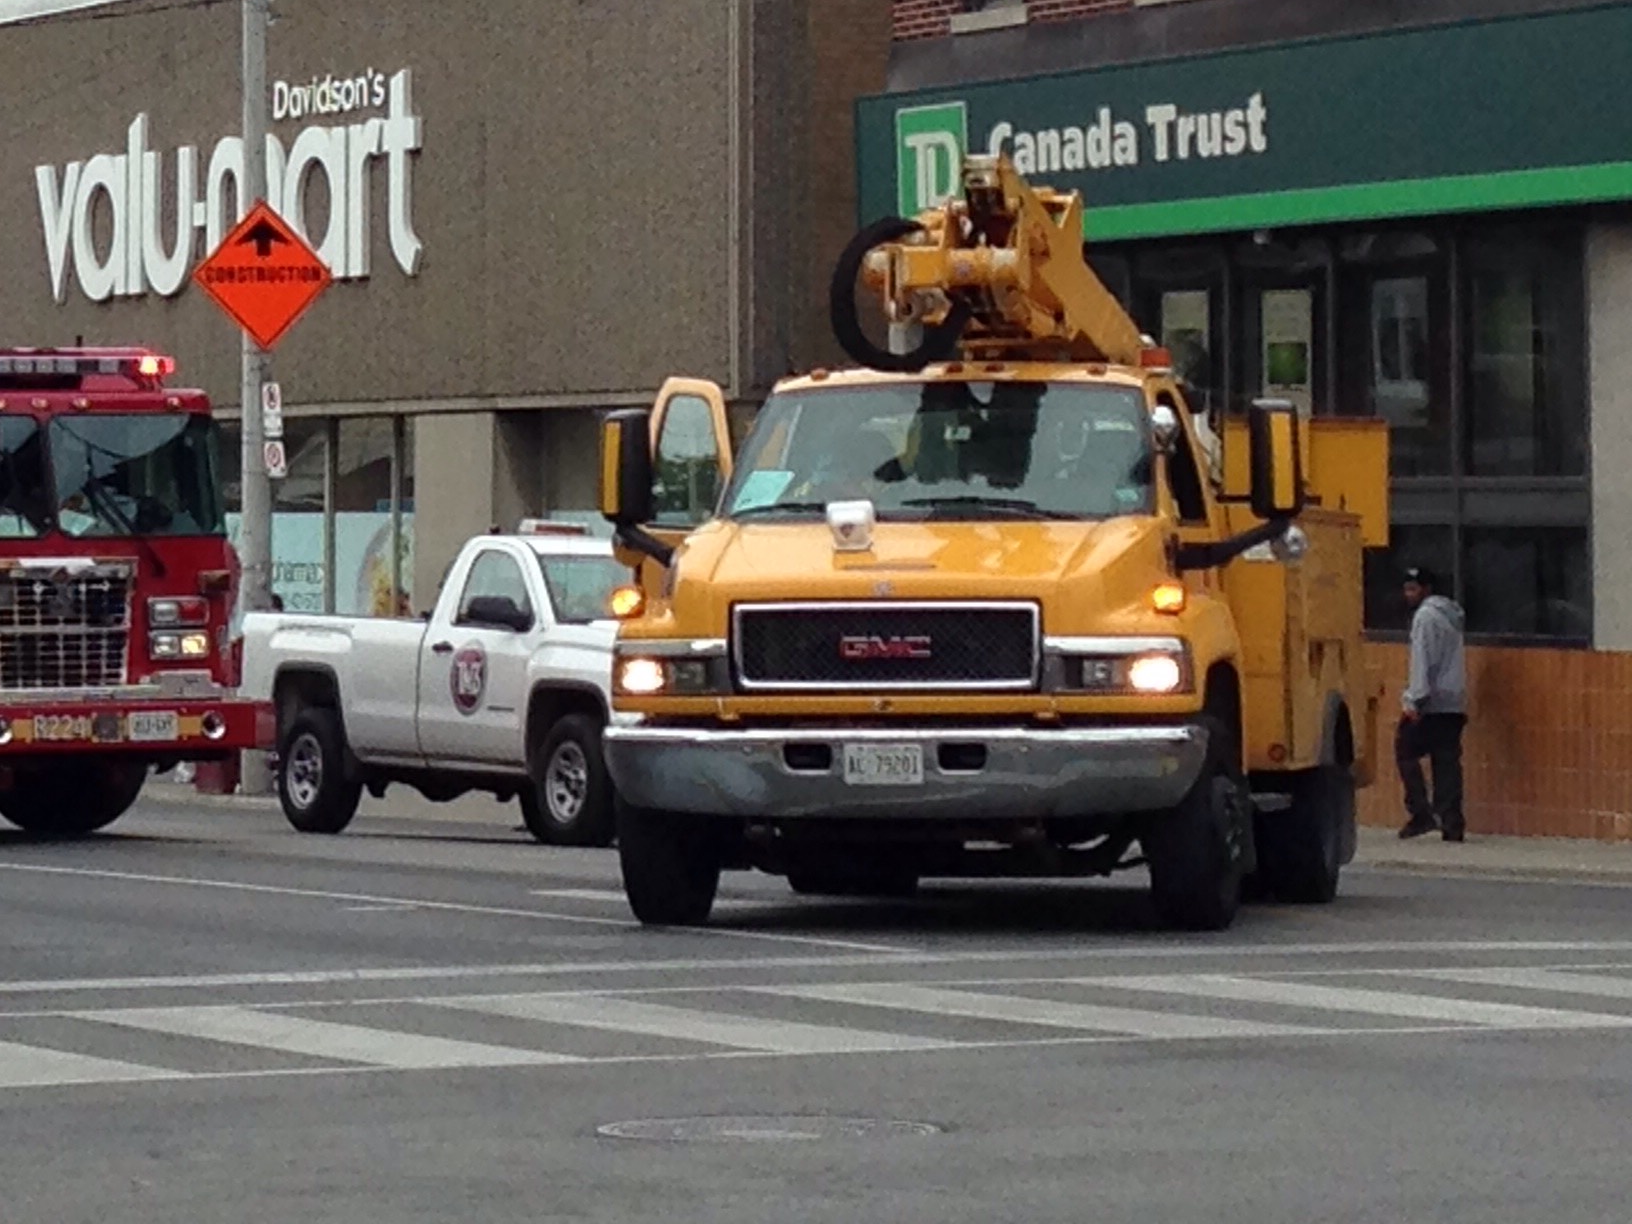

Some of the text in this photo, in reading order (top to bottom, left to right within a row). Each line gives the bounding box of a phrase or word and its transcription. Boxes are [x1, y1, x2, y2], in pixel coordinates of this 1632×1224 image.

[273, 67, 386, 121] Davidson's
[905, 91, 1268, 209] TD Canada Trust
[204, 265, 322, 283] CONSTRUCTION
[840, 635, 931, 657] GMC
